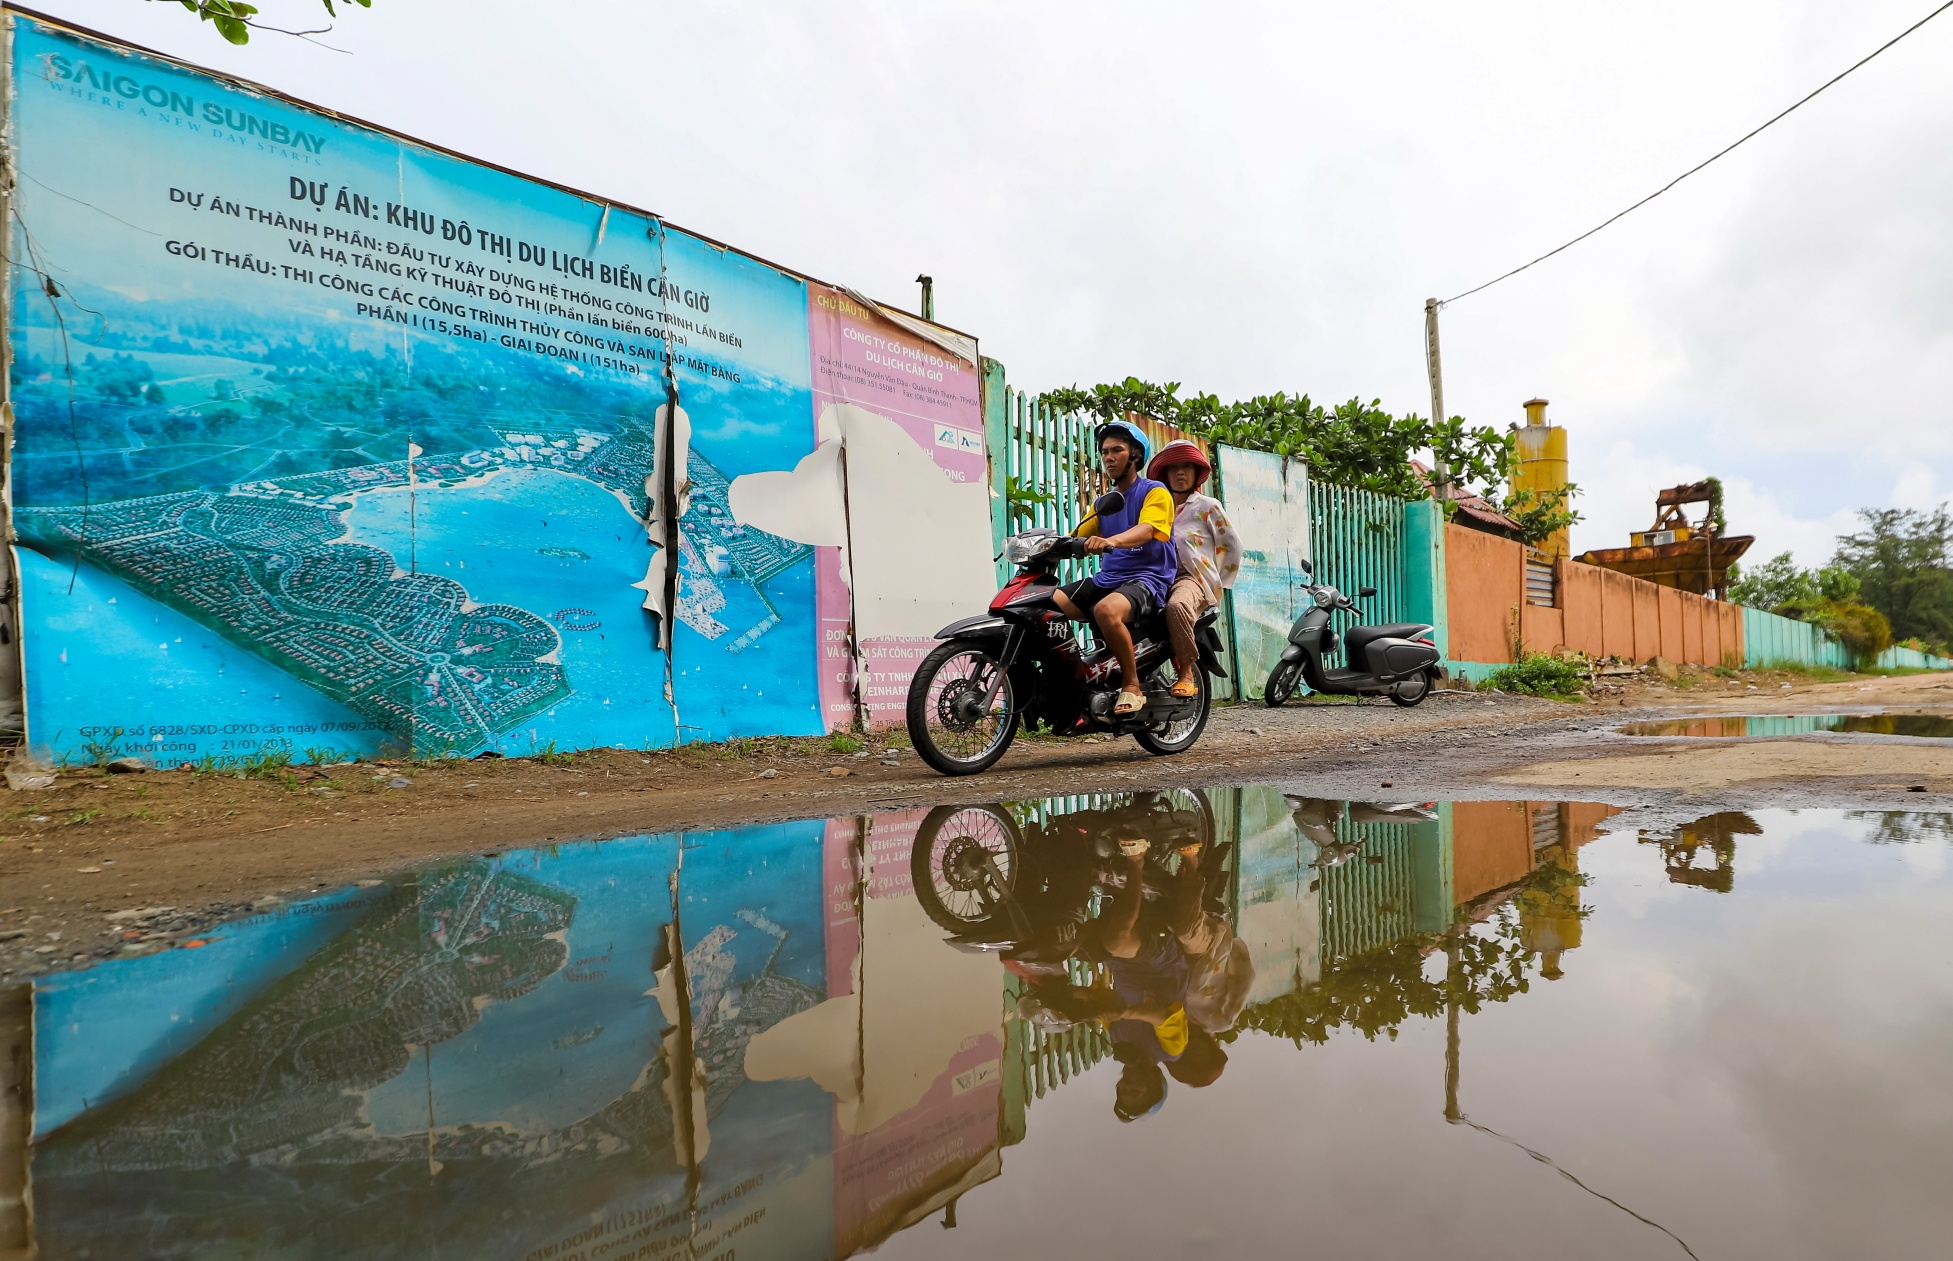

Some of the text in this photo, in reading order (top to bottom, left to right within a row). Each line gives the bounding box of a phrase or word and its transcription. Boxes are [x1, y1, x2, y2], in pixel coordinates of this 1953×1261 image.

[50, 80, 321, 166] WHERE A NEW DAY STARTS
[51, 55, 326, 154] SAIGON SUNBAY
[169, 187, 742, 349] DỰ ÁN THÀNH PHẦN: ĐẦU TƯ XÂY DỰNG HỆ THỐNG CÔNG TRÌNH LẤN BIỂN
[290, 175, 329, 212] DỰ
[335, 186, 379, 221] ÁN:
[386, 202, 435, 235] KHU
[441, 219, 473, 246] ĐÔ
[477, 229, 512, 264] THỊ
[518, 241, 546, 267] DU
[552, 251, 594, 280] LỊCH
[600, 264, 643, 293] BIỂN
[684, 291, 710, 313] GIỜ
[165, 240, 207, 262] GÓI
[211, 248, 277, 277] THẦU:
[280, 264, 314, 284] THI
[318, 273, 374, 297] CÔNG
[378, 286, 414, 305] CÁC
[417, 295, 466, 317] CÔNG
[469, 307, 517, 330] TRÌNH
[520, 319, 561, 339] THỦY
[563, 330, 605, 350] CÔNG
[607, 339, 626, 355] VÀ
[628, 345, 656, 361] SAN
[687, 357, 710, 375] MẶT
[288, 238, 315, 258] VÀ
[320, 246, 348, 268] HẠ
[351, 252, 402, 277] TẦNG
[406, 266, 429, 283] KỸ
[431, 272, 486, 298] THUẬT
[488, 288, 513, 304] ĐÔ
[515, 294, 541, 315] THỊ
[587, 311, 608, 328] lấn
[612, 318, 641, 335] biển
[817, 294, 837, 310] CHỦ
[857, 307, 870, 320] TƯ
[356, 302, 408, 325] PHẦN
[413, 314, 418, 327] I
[422, 316, 488, 343] (15,5ha)
[500, 335, 532, 352] GIAI
[535, 341, 580, 363] ĐOẠN
[582, 352, 587, 363] I
[590, 353, 641, 376] (151ha)
[843, 327, 872, 346] CÔNG
[872, 336, 886, 350] TY
[929, 355, 944, 369] ĐÔ
[944, 360, 959, 375] THỊ
[866, 355, 881, 369] DU
[882, 360, 904, 376] LỊCH
[927, 369, 944, 383] GIỜ
[826, 645, 840, 658] VÀ
[871, 645, 888, 659] SÁT
[889, 645, 914, 659] CÔNG
[874, 673, 886, 682] TY
[129, 724, 145, 737] số
[262, 722, 285, 735] cấp
[288, 722, 318, 735] ngày
[161, 741, 197, 754] công
